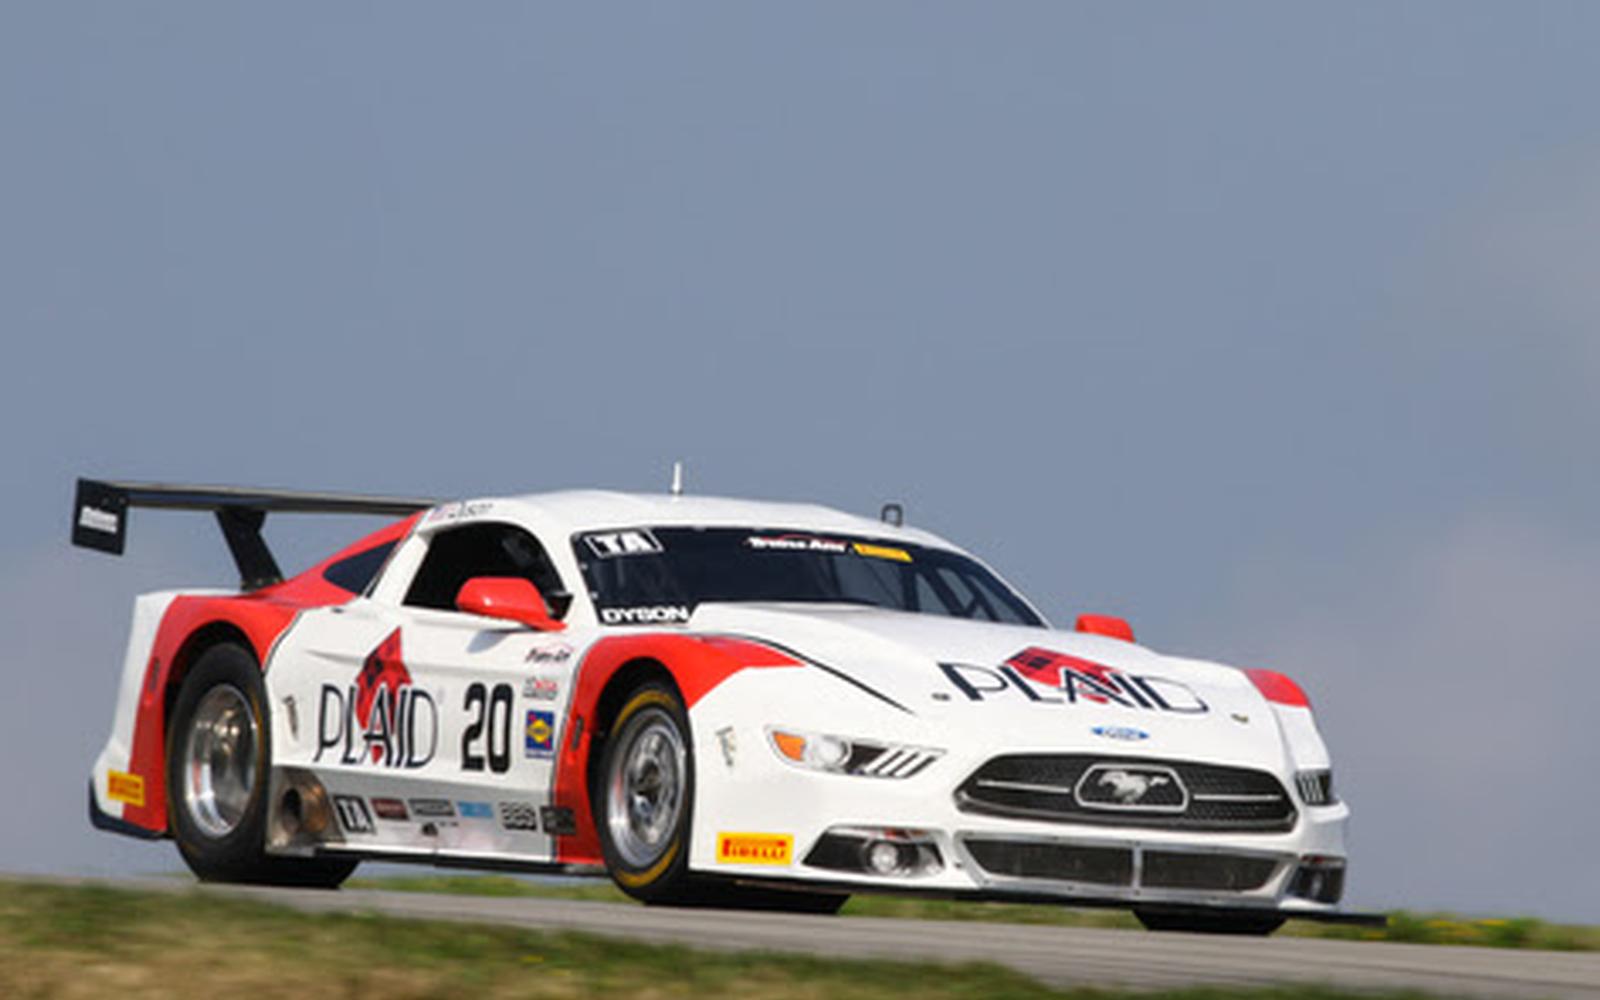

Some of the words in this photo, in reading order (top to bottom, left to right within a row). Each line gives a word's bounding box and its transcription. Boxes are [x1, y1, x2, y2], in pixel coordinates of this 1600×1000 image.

[593, 531, 656, 554] TA
[601, 606, 690, 624] DYSON
[937, 661, 1210, 714] PLAID
[313, 683, 439, 769] PLAID
[461, 682, 514, 775] 20
